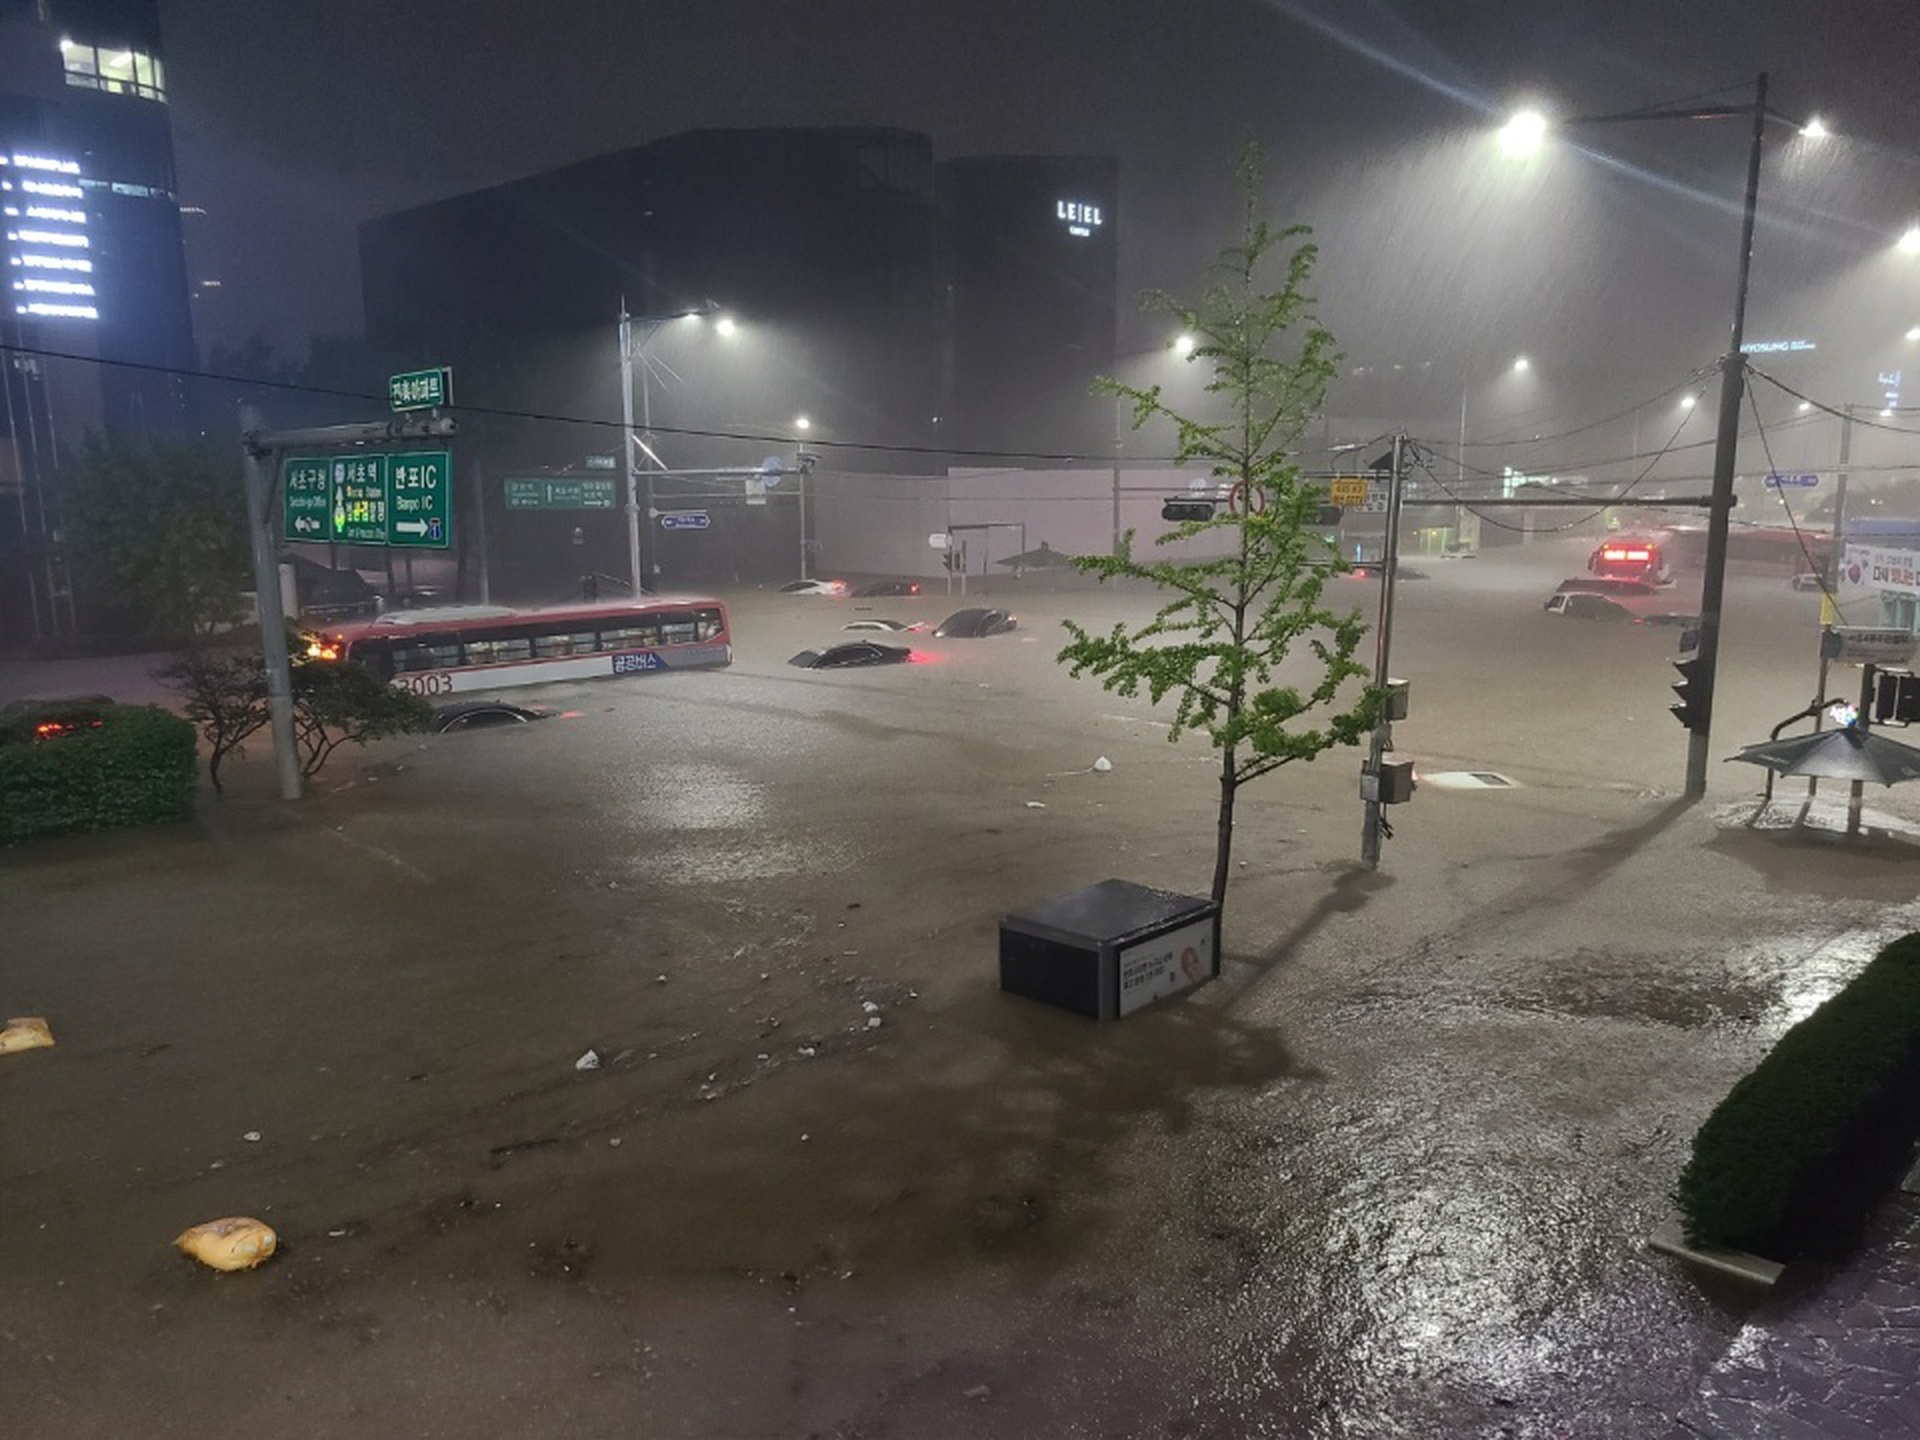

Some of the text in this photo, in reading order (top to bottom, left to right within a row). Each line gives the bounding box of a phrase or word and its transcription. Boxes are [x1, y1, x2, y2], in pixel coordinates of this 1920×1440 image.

[289, 468, 326, 491] 서초구청
[395, 465, 437, 490] 반포IC
[421, 495, 433, 510] IC
